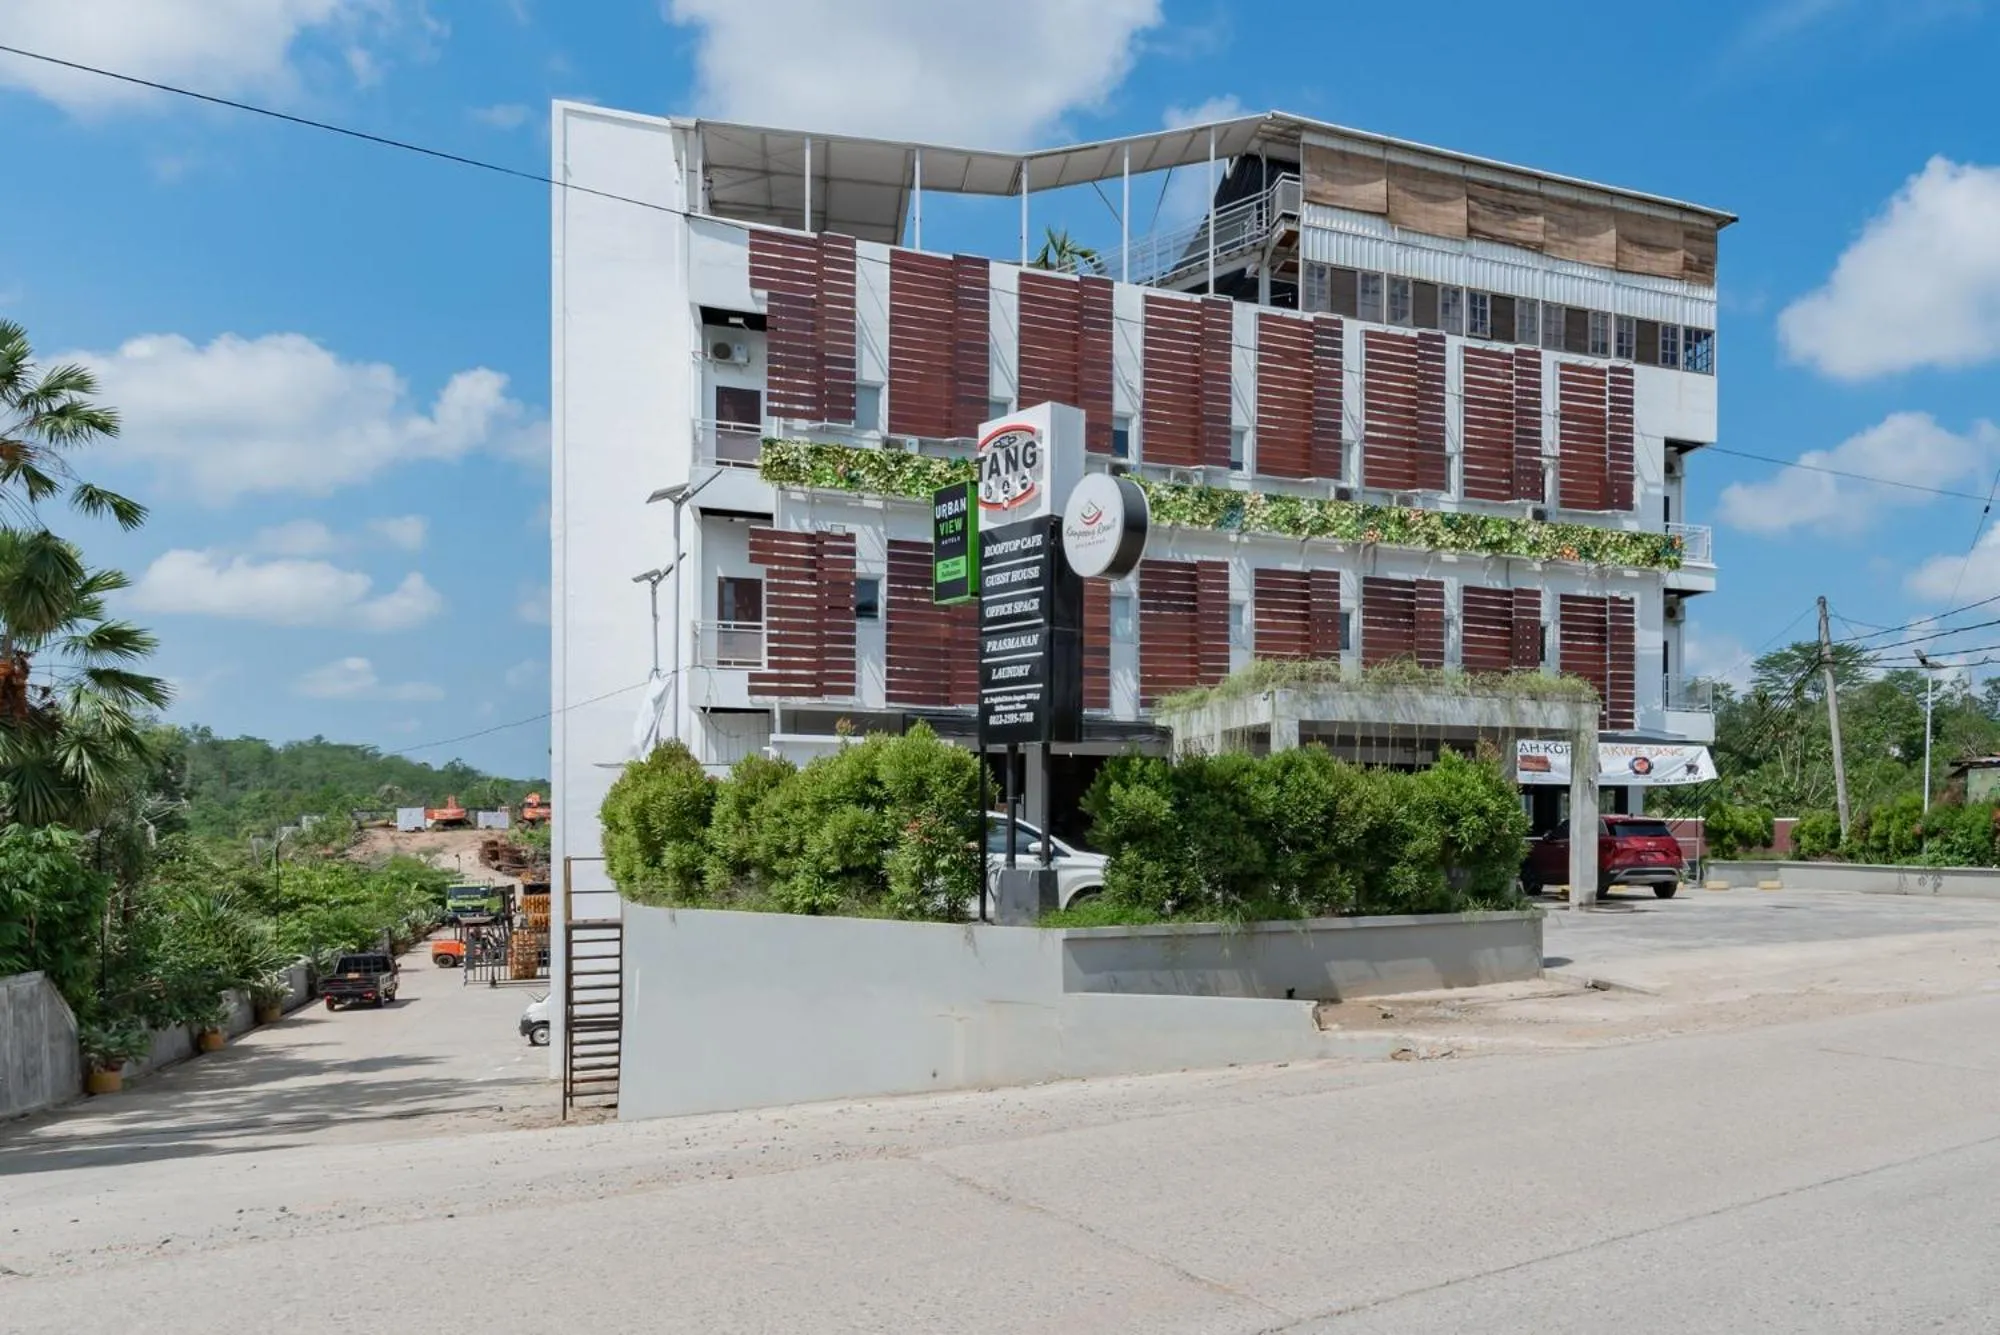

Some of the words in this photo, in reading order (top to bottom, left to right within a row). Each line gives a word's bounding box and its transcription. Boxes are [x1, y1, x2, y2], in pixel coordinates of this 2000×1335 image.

[974, 441, 1036, 482] TANG
[935, 497, 967, 519] URBAN
[939, 517, 963, 536] VIEW
[984, 539, 1021, 558] ROOFTOP
[1021, 534, 1043, 549] CAFE
[985, 571, 1012, 587] GUEST
[1011, 566, 1040, 582] HOUSE
[986, 602, 1013, 618] OFFICE
[1013, 598, 1040, 613] SPACE
[986, 633, 1039, 652] PRASMANAN
[991, 664, 1031, 680] LAUNDRY
